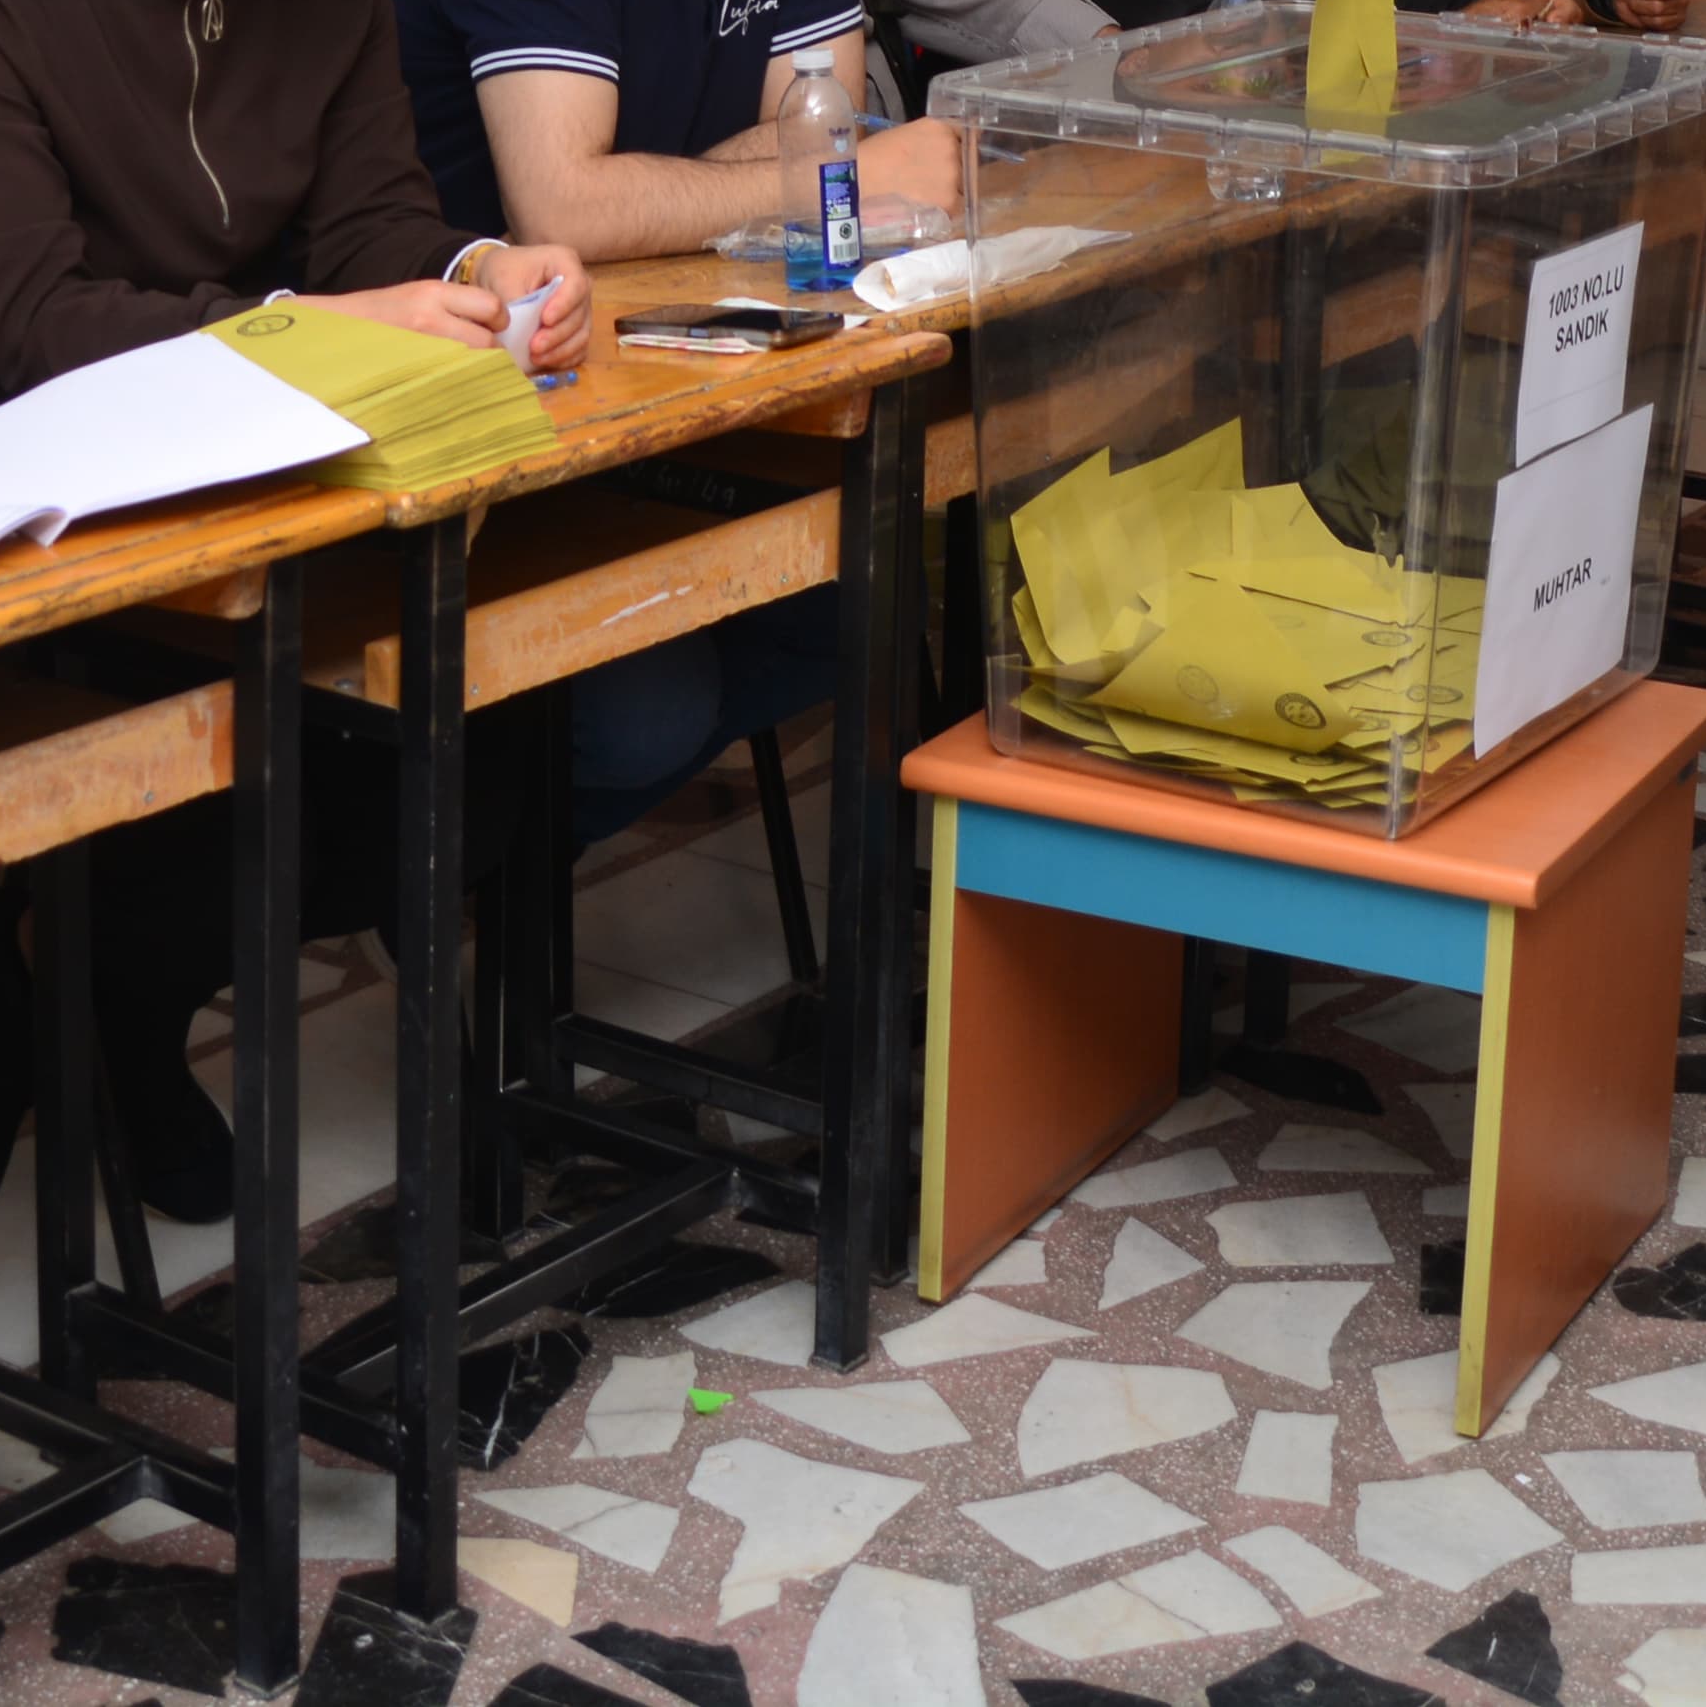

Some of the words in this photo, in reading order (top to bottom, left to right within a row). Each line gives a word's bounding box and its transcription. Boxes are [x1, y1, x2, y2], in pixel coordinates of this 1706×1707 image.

[1549, 283, 1580, 319] 1003
[1581, 264, 1625, 306] NO.LU
[1555, 308, 1610, 353] SANDIK
[1533, 557, 1593, 613] MUHTAR
